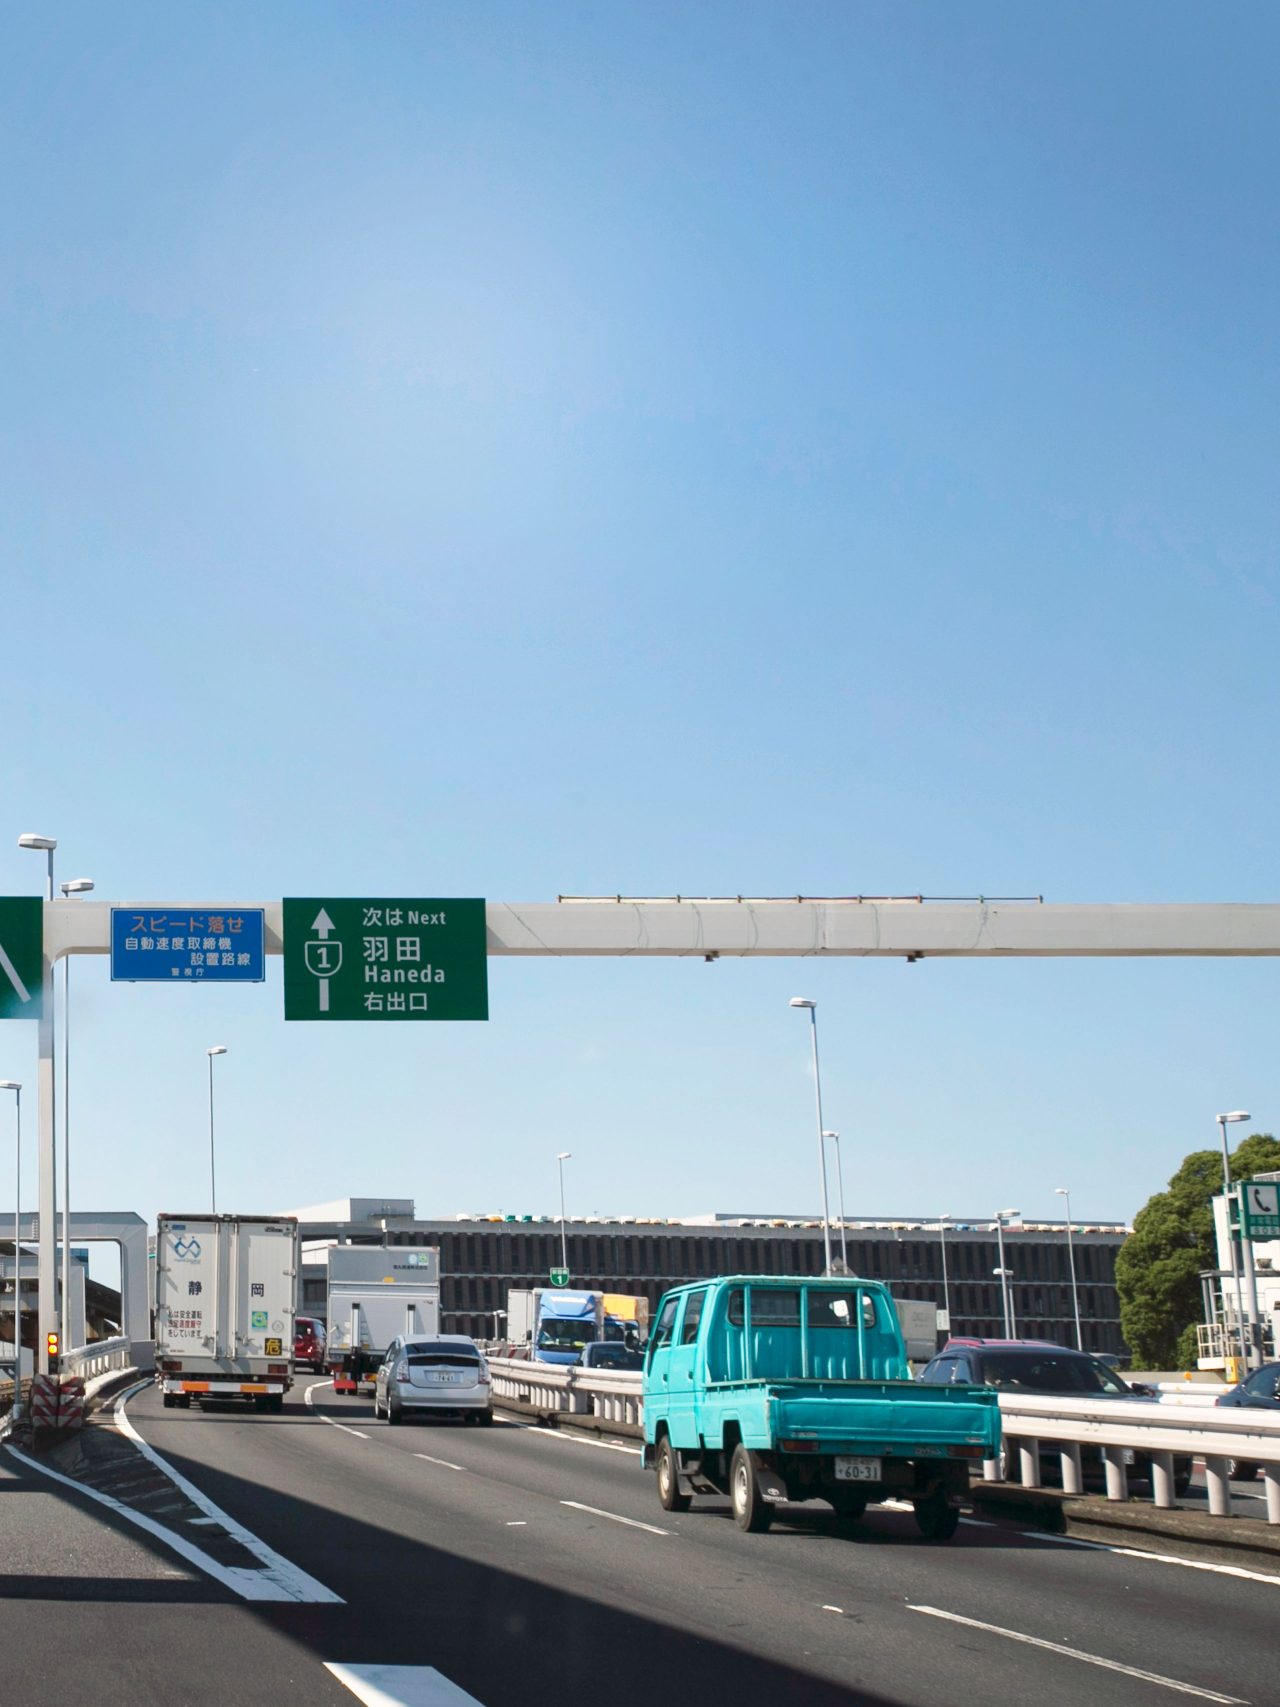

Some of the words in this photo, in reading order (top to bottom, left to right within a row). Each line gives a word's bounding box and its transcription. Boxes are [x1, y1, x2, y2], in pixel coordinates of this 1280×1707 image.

[130, 915, 245, 934] スピード落せ
[362, 907, 405, 927] 次は
[408, 910, 447, 925] Next
[125, 936, 232, 951] 自動速度取締機
[362, 936, 421, 962] 羽田
[190, 952, 251, 966] 設置路線
[316, 947, 332, 969] 1
[364, 963, 446, 984] Haneda
[363, 991, 428, 1012] 右出口
[557, 1275, 563, 1285] 1
[266, 1338, 280, 1355] 危
[845, 1465, 878, 1480] 60-31
